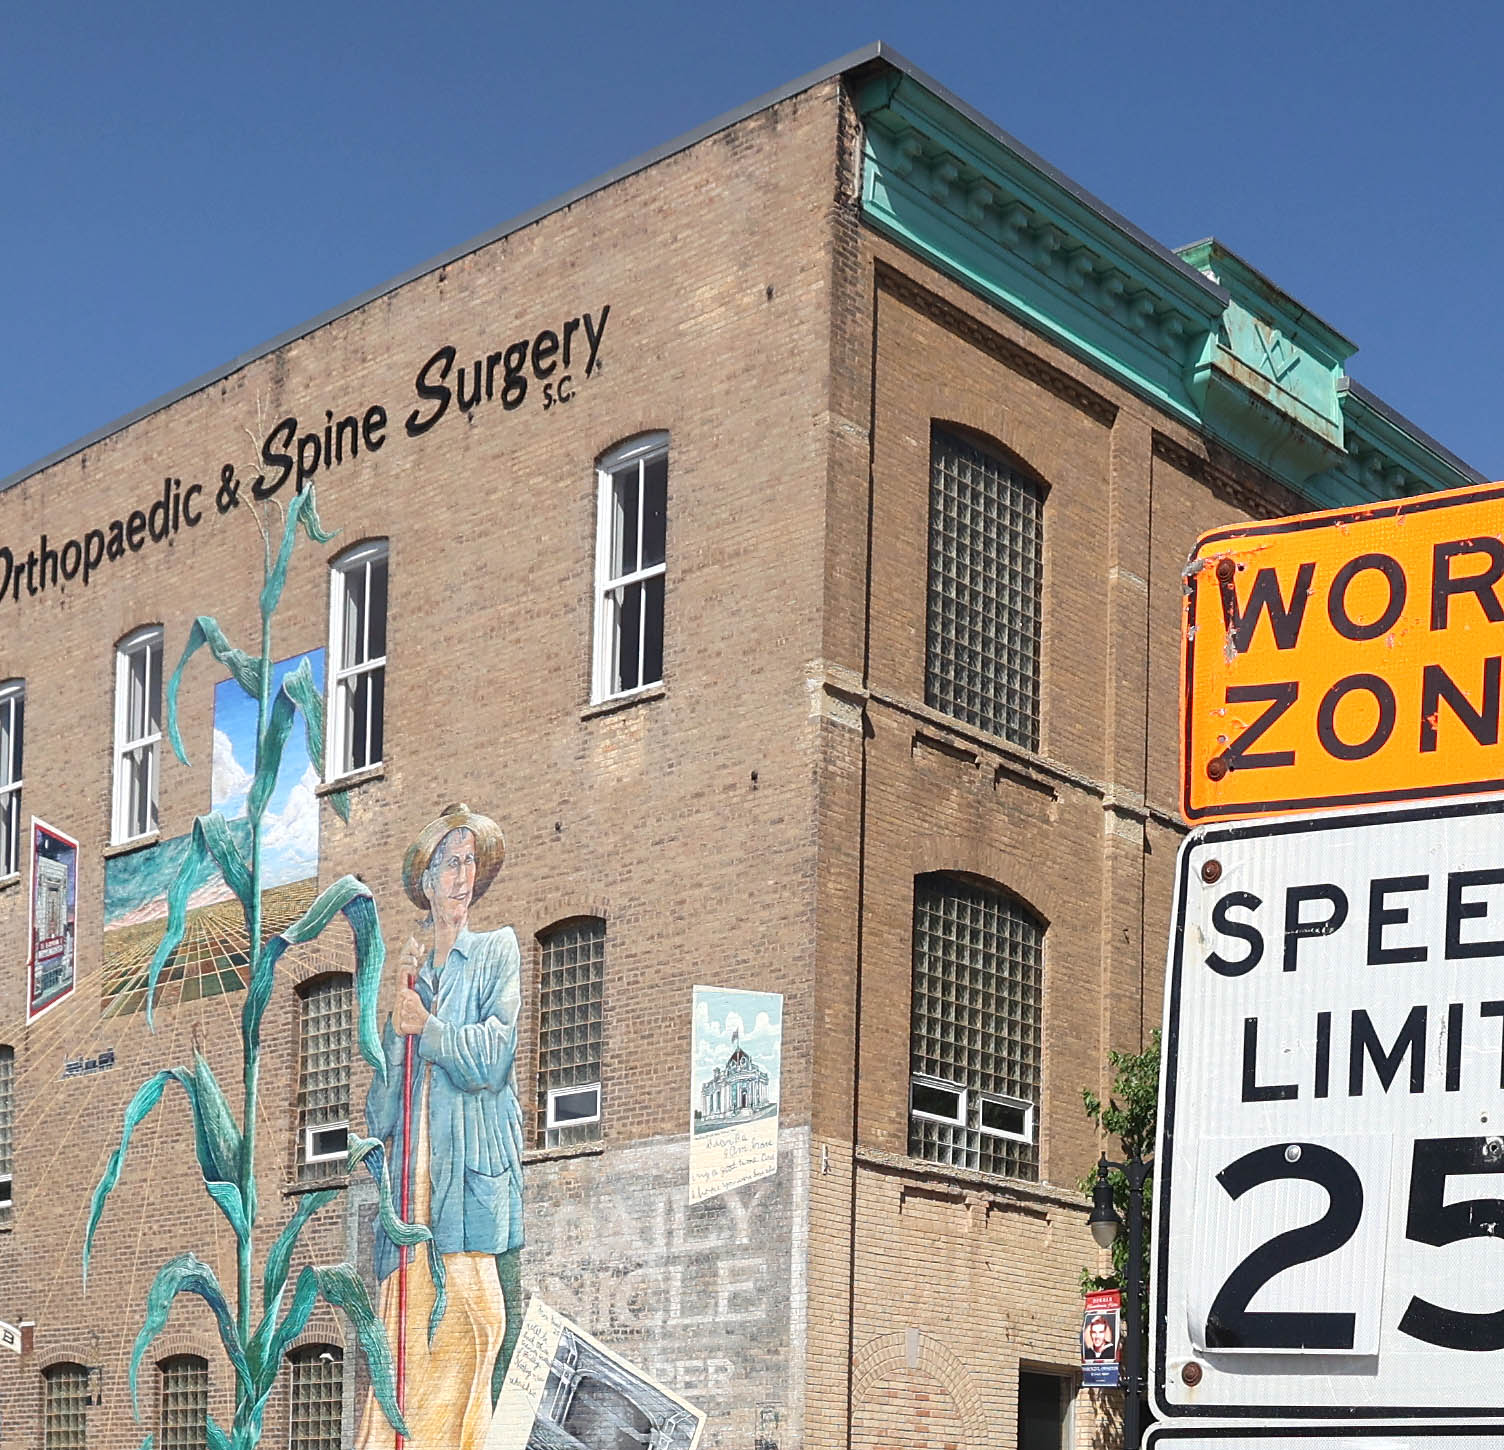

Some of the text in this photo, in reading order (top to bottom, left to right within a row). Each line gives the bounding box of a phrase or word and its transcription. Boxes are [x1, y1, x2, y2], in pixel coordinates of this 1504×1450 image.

[215, 464, 241, 515] &
[252, 404, 389, 500] Spine
[405, 304, 612, 437] Surgery
